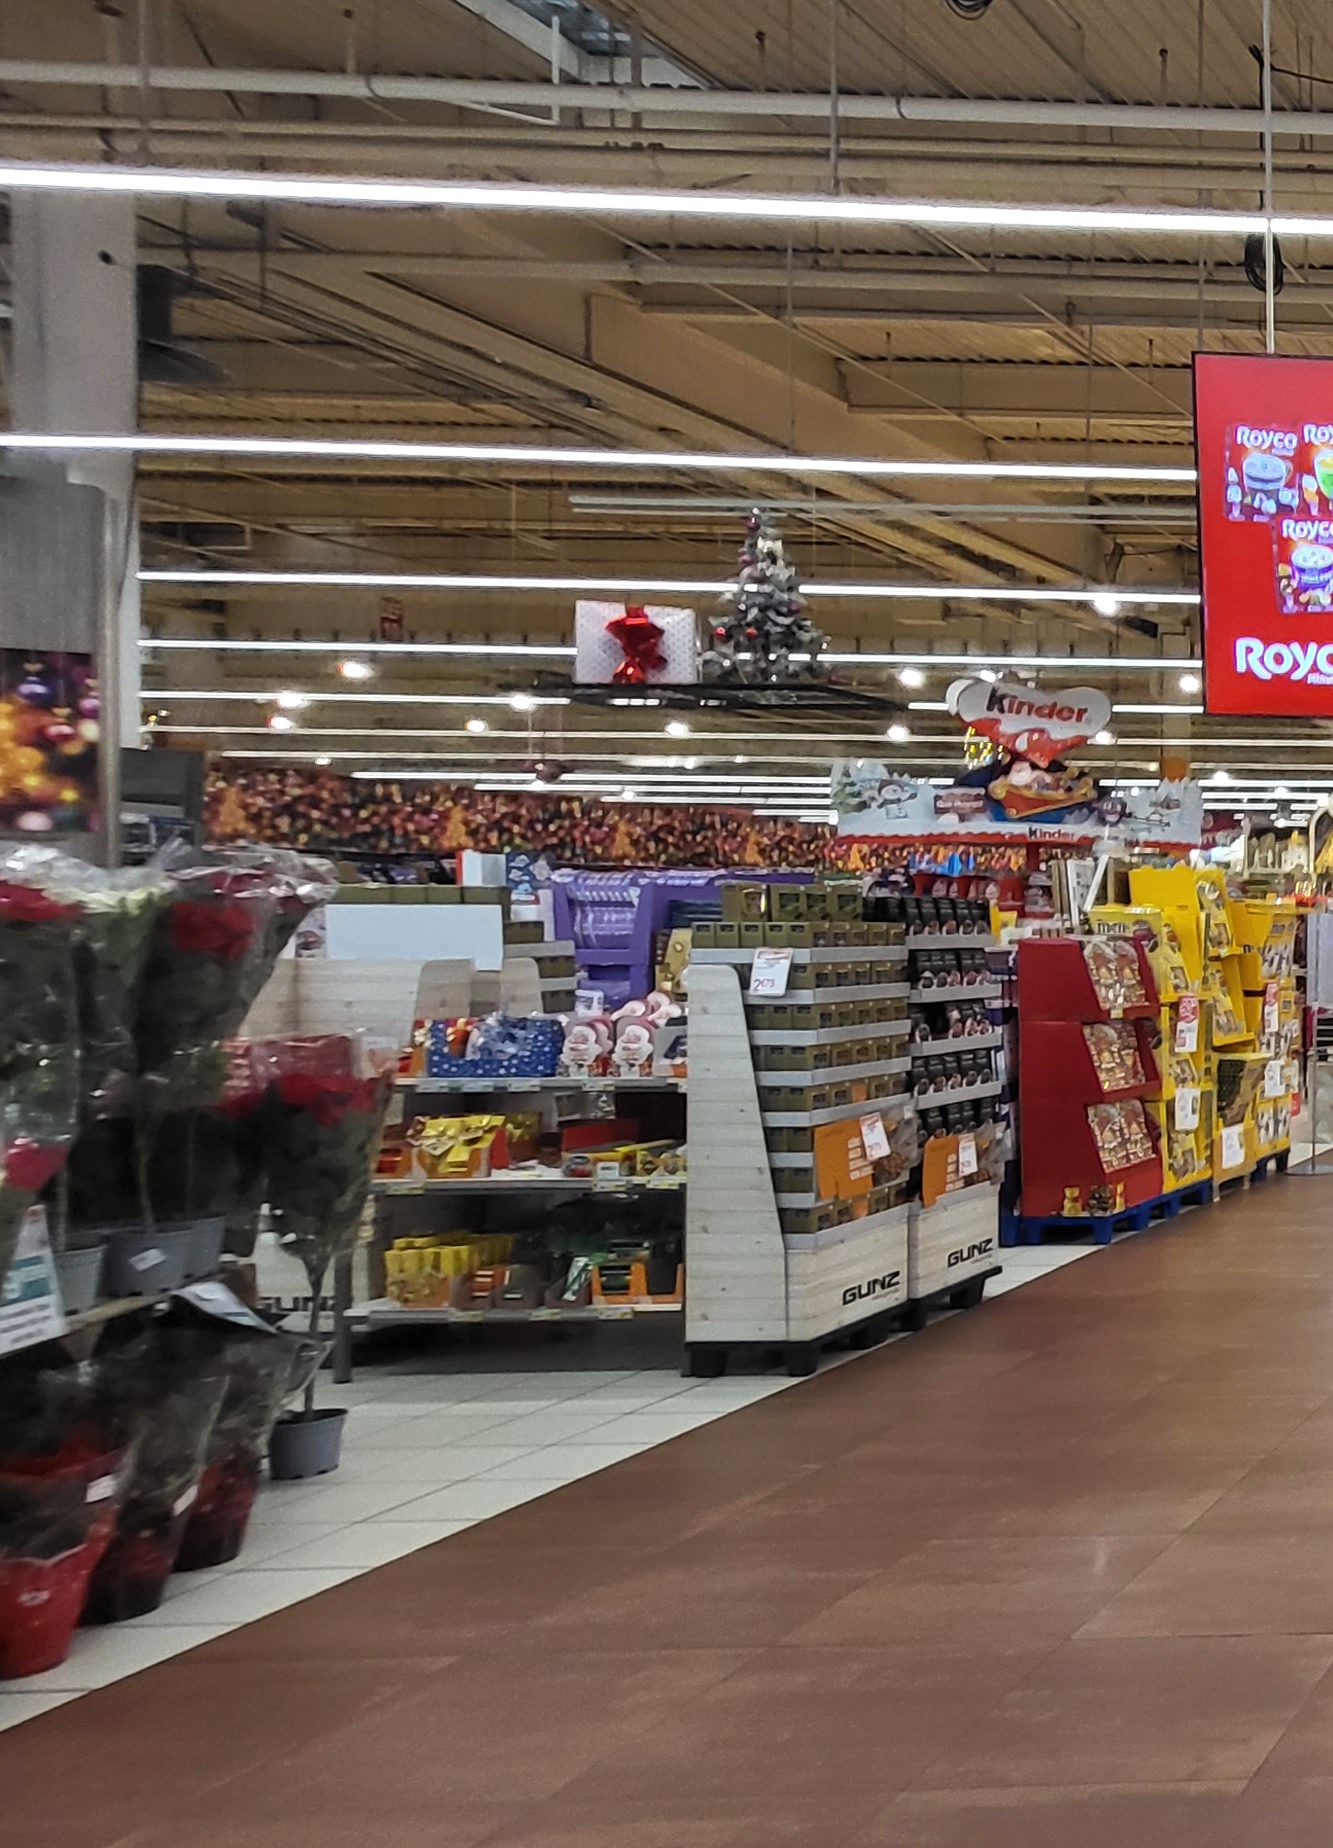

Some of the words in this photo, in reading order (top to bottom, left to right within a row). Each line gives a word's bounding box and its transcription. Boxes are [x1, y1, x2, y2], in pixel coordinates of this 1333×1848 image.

[1236, 425, 1298, 450] Royco
[986, 686, 1088, 723] Kinder
[947, 1238, 993, 1268] GUNZ
[842, 1271, 900, 1306] GUNZ
